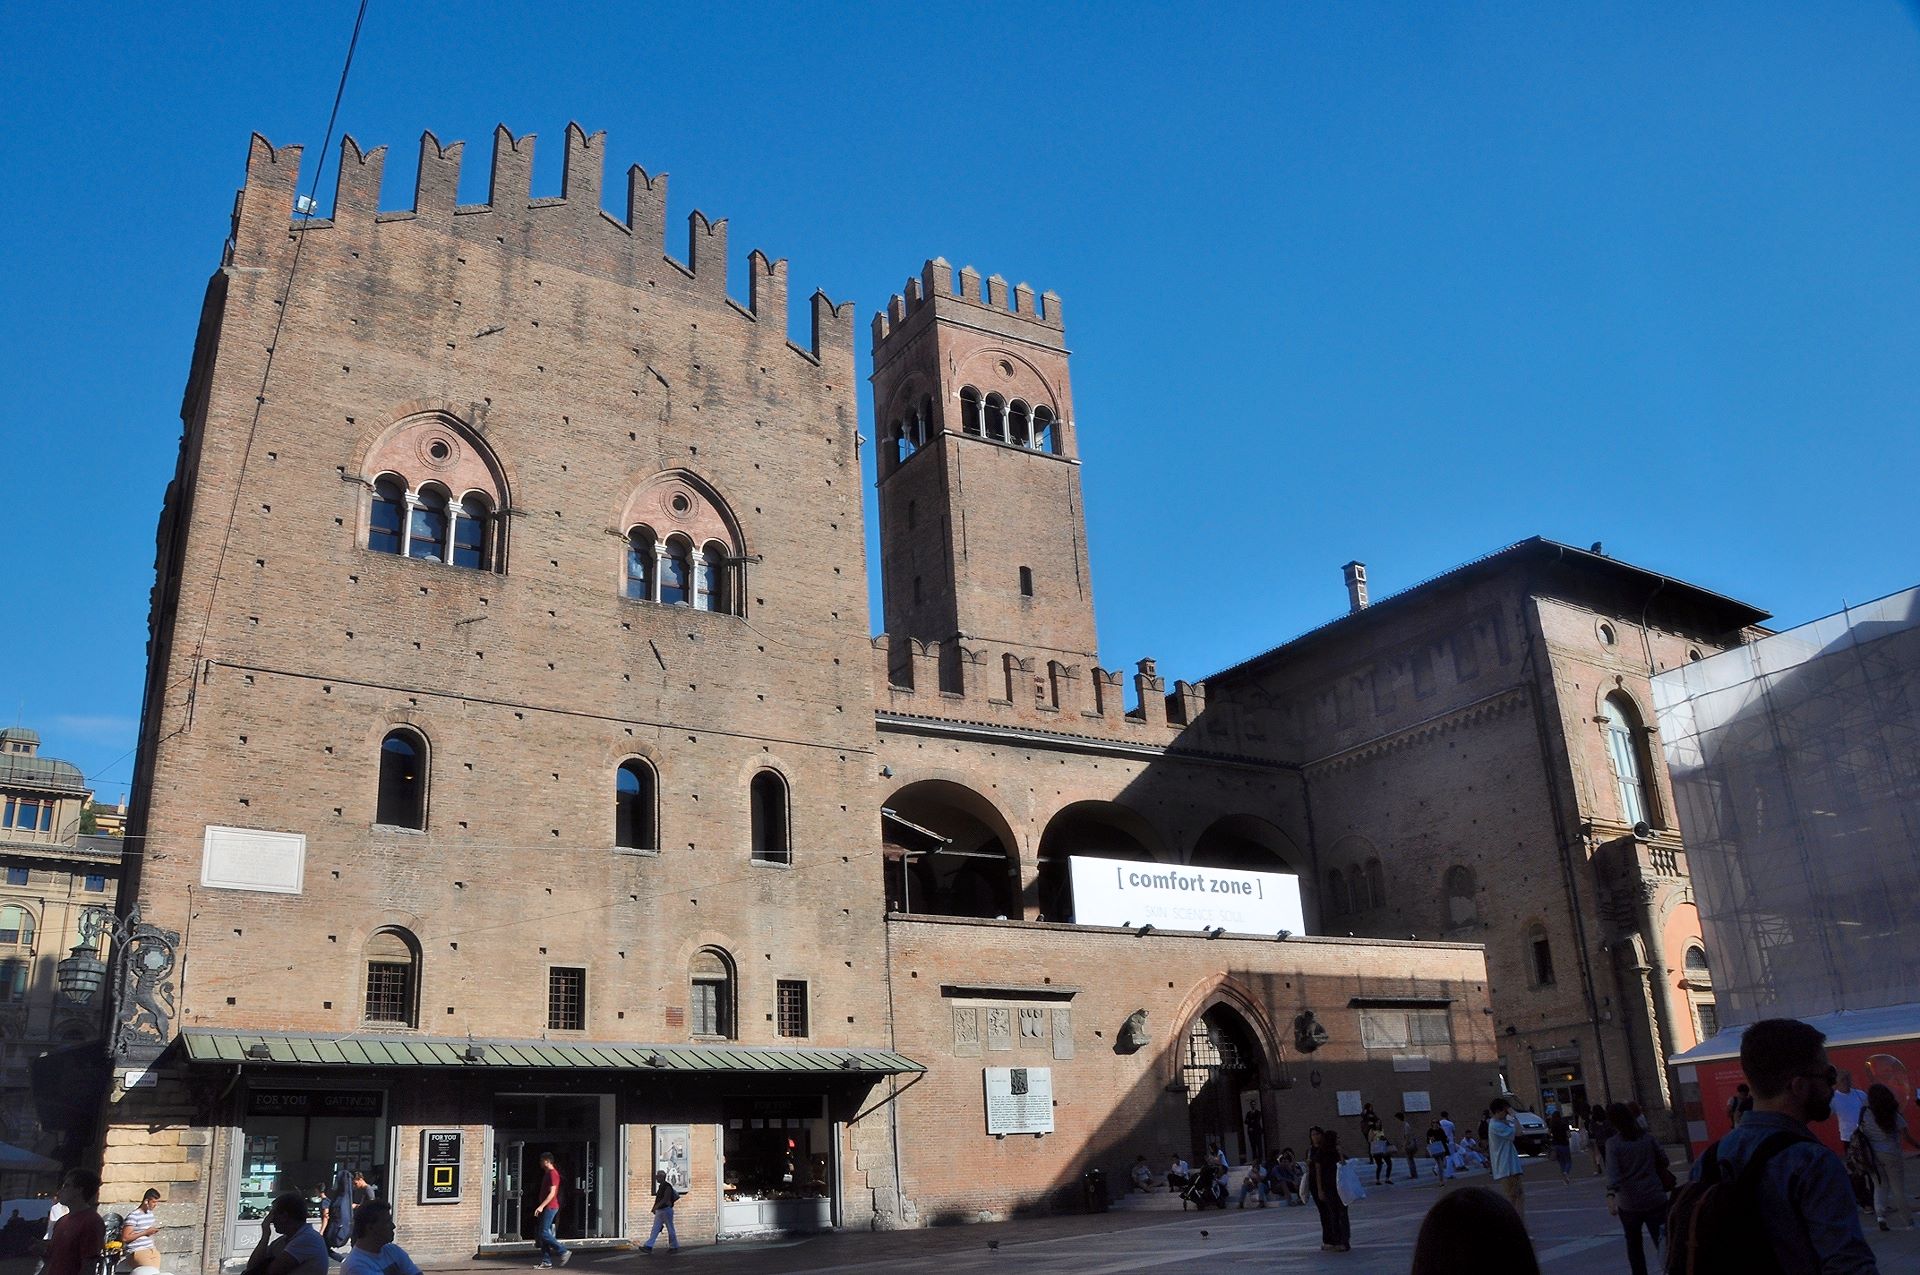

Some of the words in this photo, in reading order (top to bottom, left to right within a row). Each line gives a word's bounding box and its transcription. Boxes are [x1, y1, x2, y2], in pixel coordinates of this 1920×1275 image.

[1129, 871, 1206, 893] comfort
[1210, 879, 1252, 895] zone
[1173, 906, 1214, 922] SCIENCE
[256, 1094, 280, 1105] FOR
[282, 1095, 308, 1105] YOU
